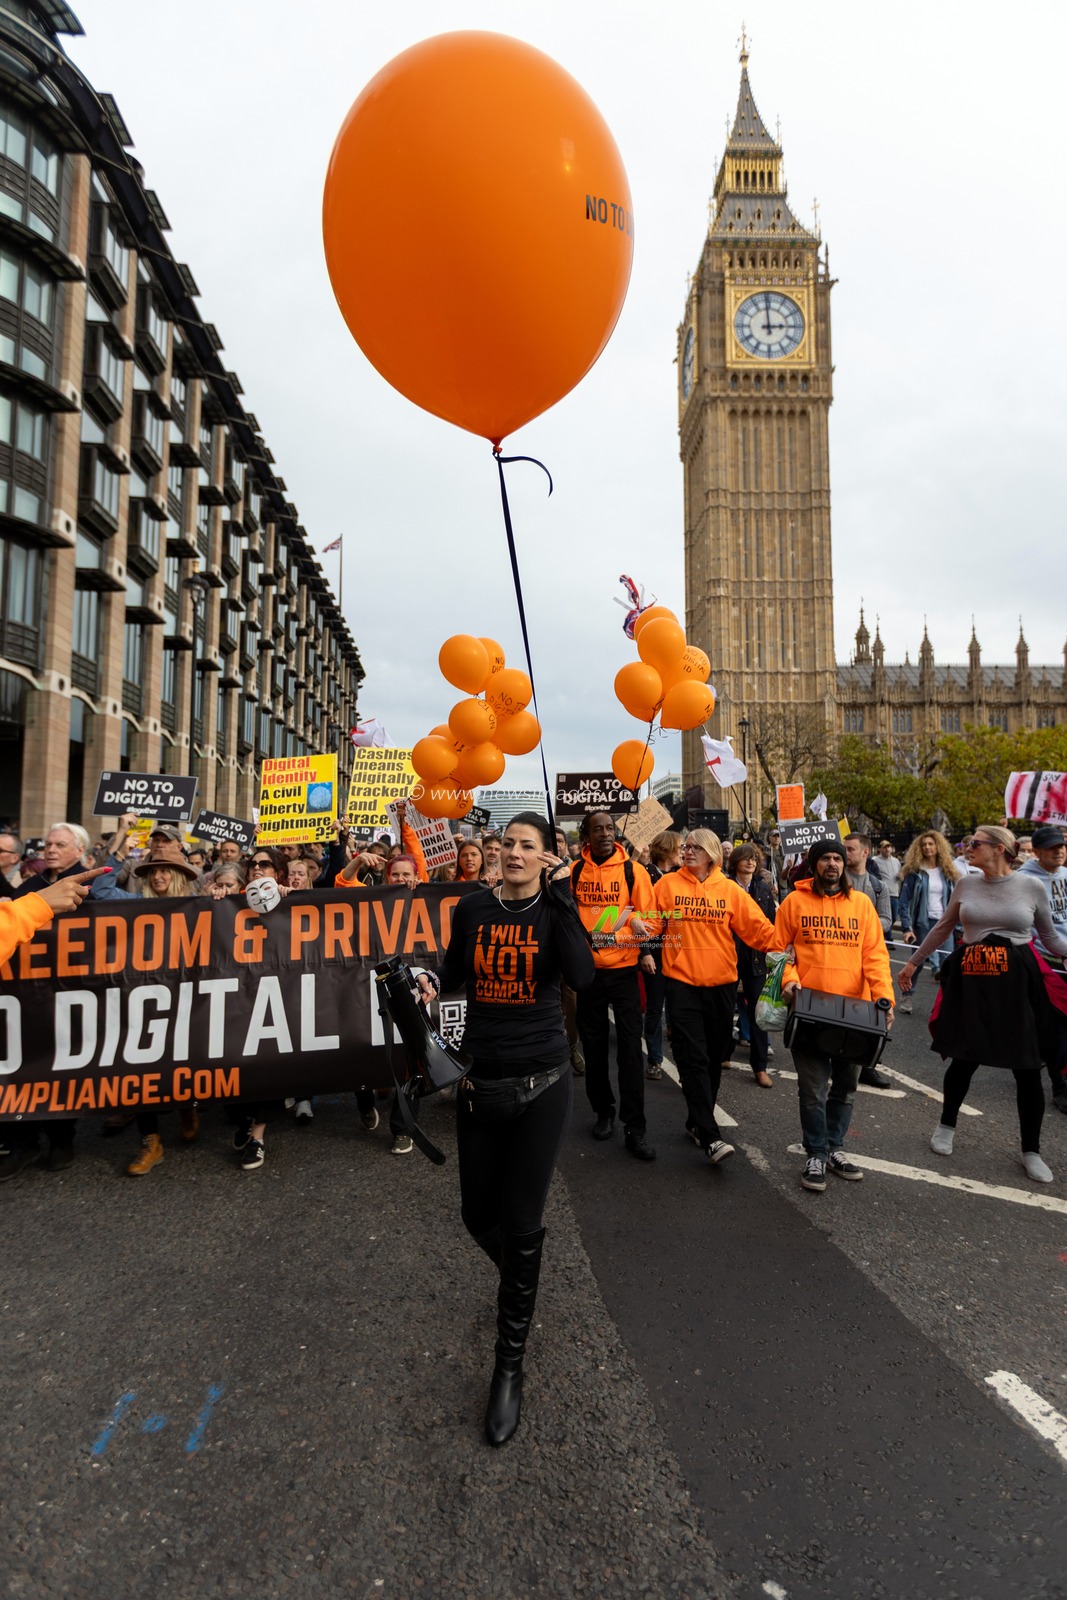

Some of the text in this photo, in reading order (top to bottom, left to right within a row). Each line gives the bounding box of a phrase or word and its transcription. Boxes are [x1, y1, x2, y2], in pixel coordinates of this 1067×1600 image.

[585, 194, 608, 225] NO
[610, 202, 625, 232] TO
[498, 692, 512, 706] NO
[264, 757, 311, 772] Digital
[354, 761, 404, 771] means
[262, 771, 317, 785] Identity
[353, 772, 415, 785] digitally
[580, 778, 622, 790] NO TO
[1043, 773, 1061, 782] SAY
[124, 779, 174, 793] NO TO
[261, 786, 302, 800] A civil
[351, 786, 409, 797] tracked
[103, 791, 185, 808] DIGITAL ID
[563, 790, 632, 804] DIGITAL ID
[260, 803, 305, 816] liberty
[349, 799, 378, 811] and
[474, 808, 483, 816] TO
[212, 816, 244, 832] NO TO
[260, 816, 331, 832] nightmare
[361, 827, 371, 835] ID
[434, 822, 445, 833] ID
[795, 825, 826, 836] NO TO
[198, 822, 235, 840] DIGITAL
[236, 832, 248, 843] ID
[426, 851, 456, 868] NOUGH
[611, 881, 620, 892] ID
[674, 895, 726, 909] DIGITAL ID
[684, 907, 726, 919] TYRANNY
[290, 896, 462, 961] PRIVAC
[801, 915, 859, 930] DIGITAL ID
[476, 924, 539, 946] I WILL
[813, 928, 860, 941] TYRANNY
[473, 943, 539, 982] NOT
[985, 951, 1008, 964] ME!
[973, 964, 998, 972] DIGITAL
[1000, 964, 1008, 972] ID
[475, 980, 537, 999] COMPLY
[51, 974, 340, 1071] DIGITAL
[0, 1066, 240, 1114] MPLIANCE.COM
